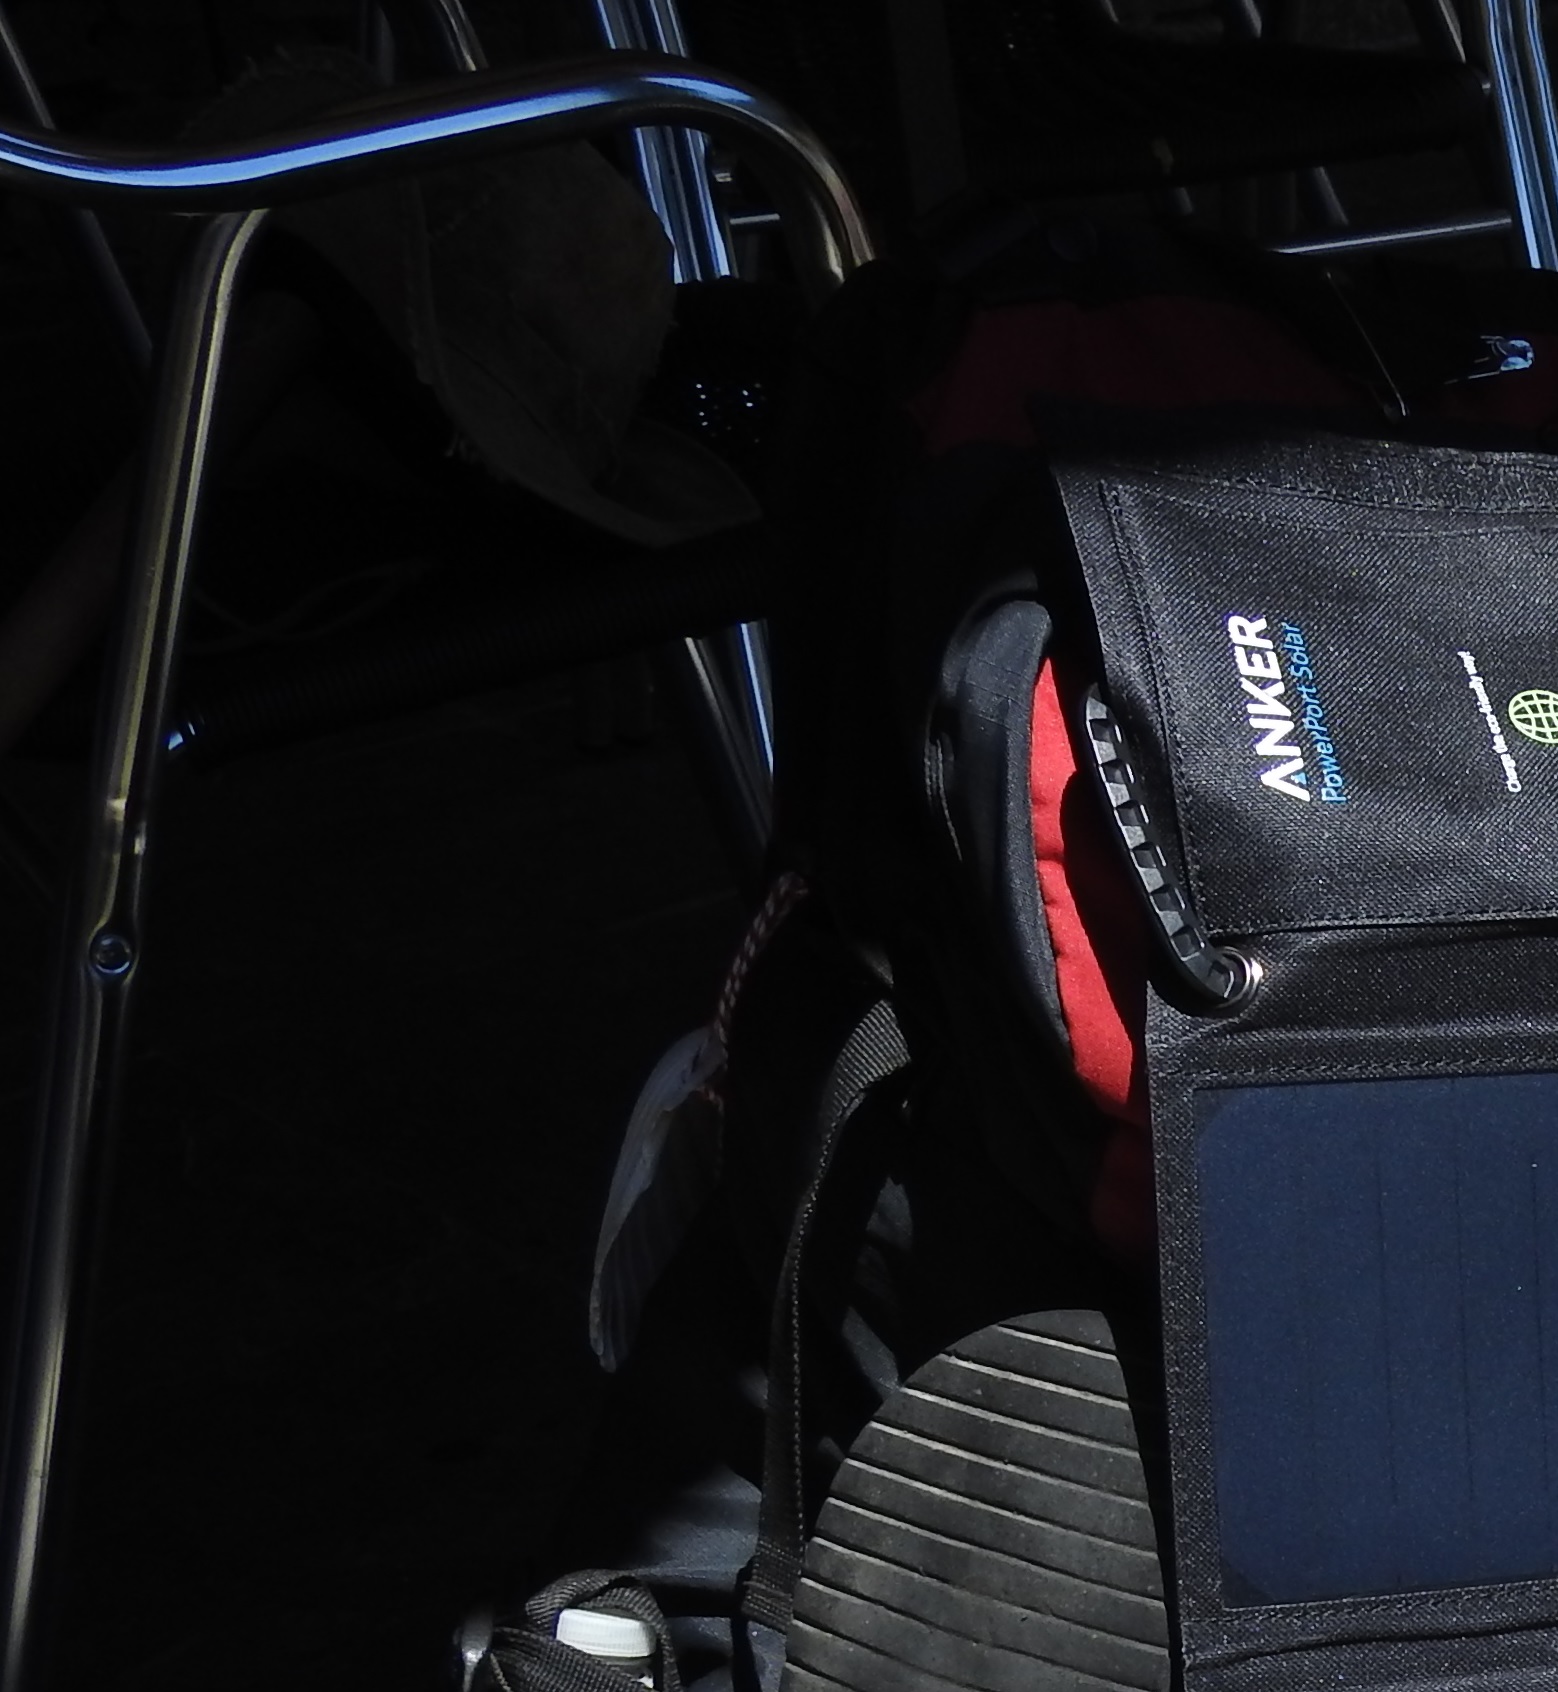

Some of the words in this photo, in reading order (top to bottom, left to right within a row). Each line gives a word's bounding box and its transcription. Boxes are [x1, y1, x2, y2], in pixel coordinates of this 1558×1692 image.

[1227, 615, 1311, 801] ANKER
[1280, 621, 1314, 681] Solar
[1296, 684, 1347, 802] PowerPort
